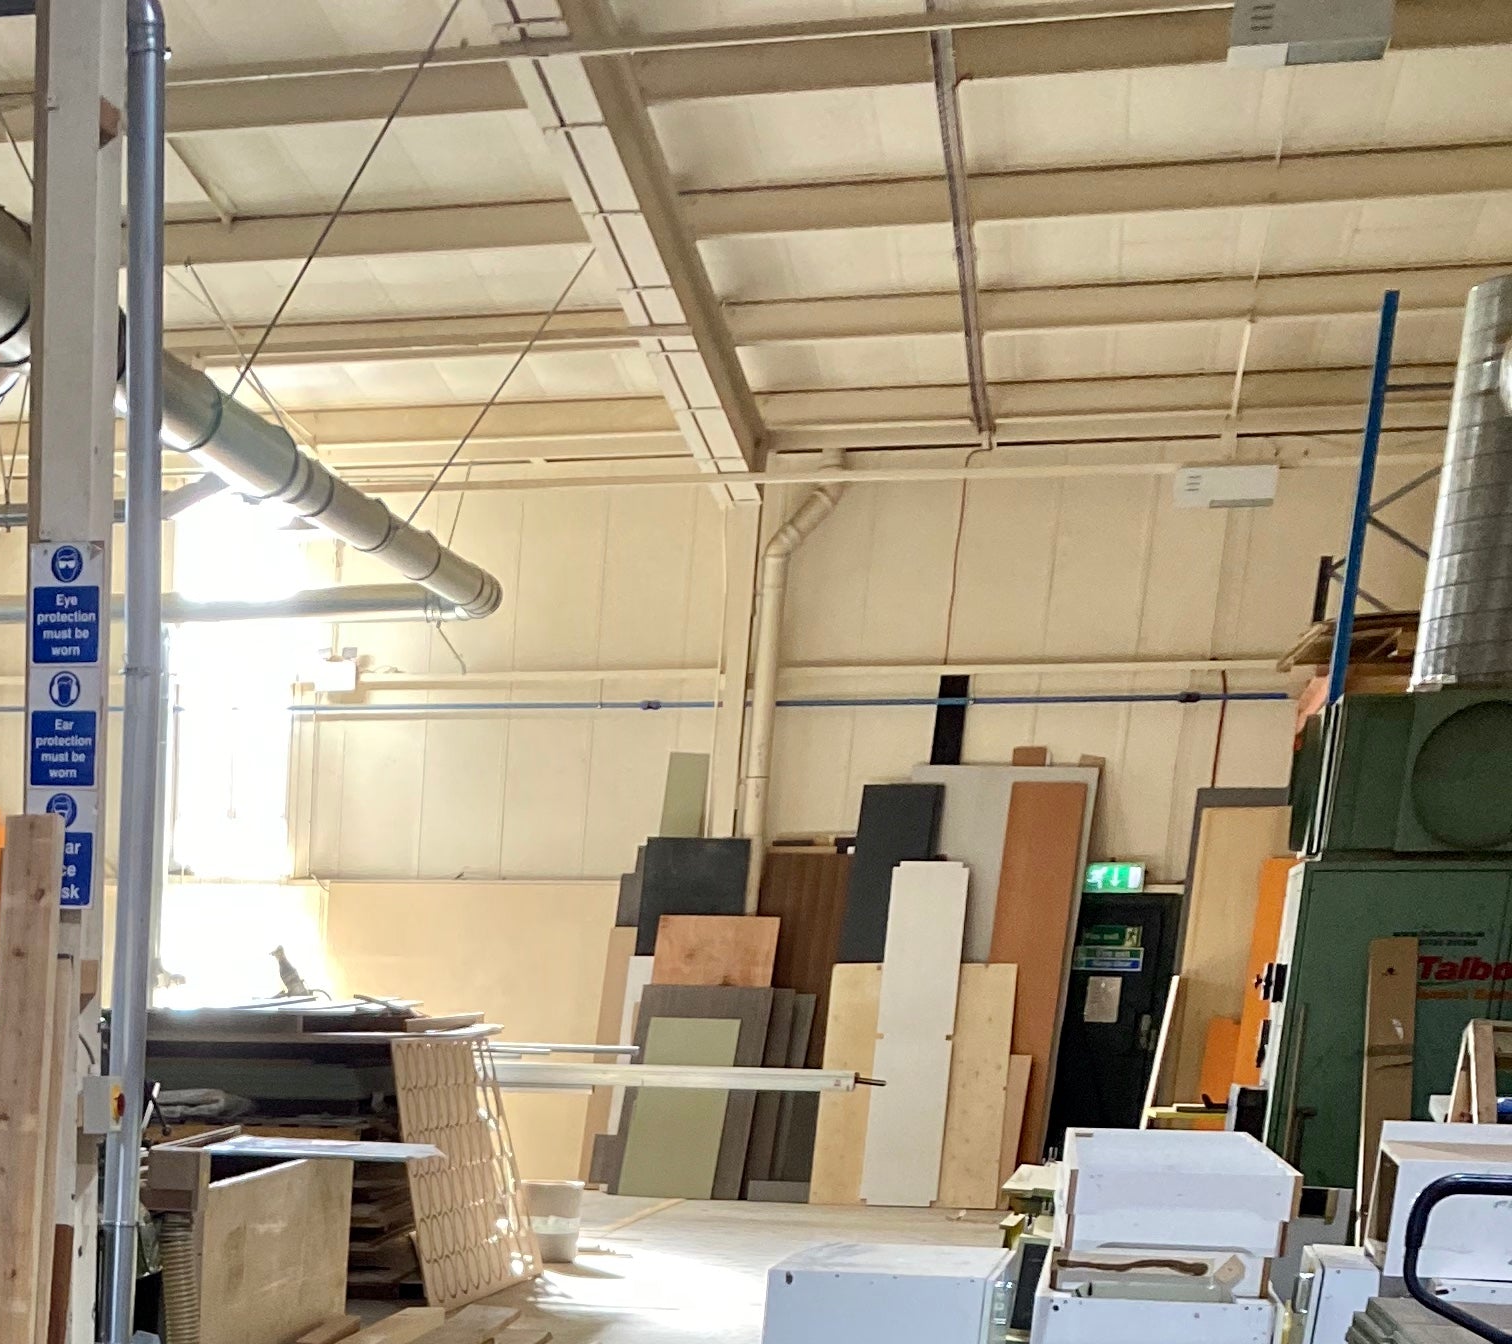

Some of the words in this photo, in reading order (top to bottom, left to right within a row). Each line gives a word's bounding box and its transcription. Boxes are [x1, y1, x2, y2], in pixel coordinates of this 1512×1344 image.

[56, 593, 78, 608] Eye
[37, 610, 96, 625] protection
[43, 627, 72, 639] must
[74, 626, 90, 639] be
[51, 645, 81, 656] worn
[54, 718, 75, 731] Ear
[35, 734, 92, 749] protection
[41, 751, 69, 762] must
[71, 750, 86, 762] be
[48, 768, 77, 778] worn
[65, 842, 81, 855] ar
[61, 883, 80, 899] sk
